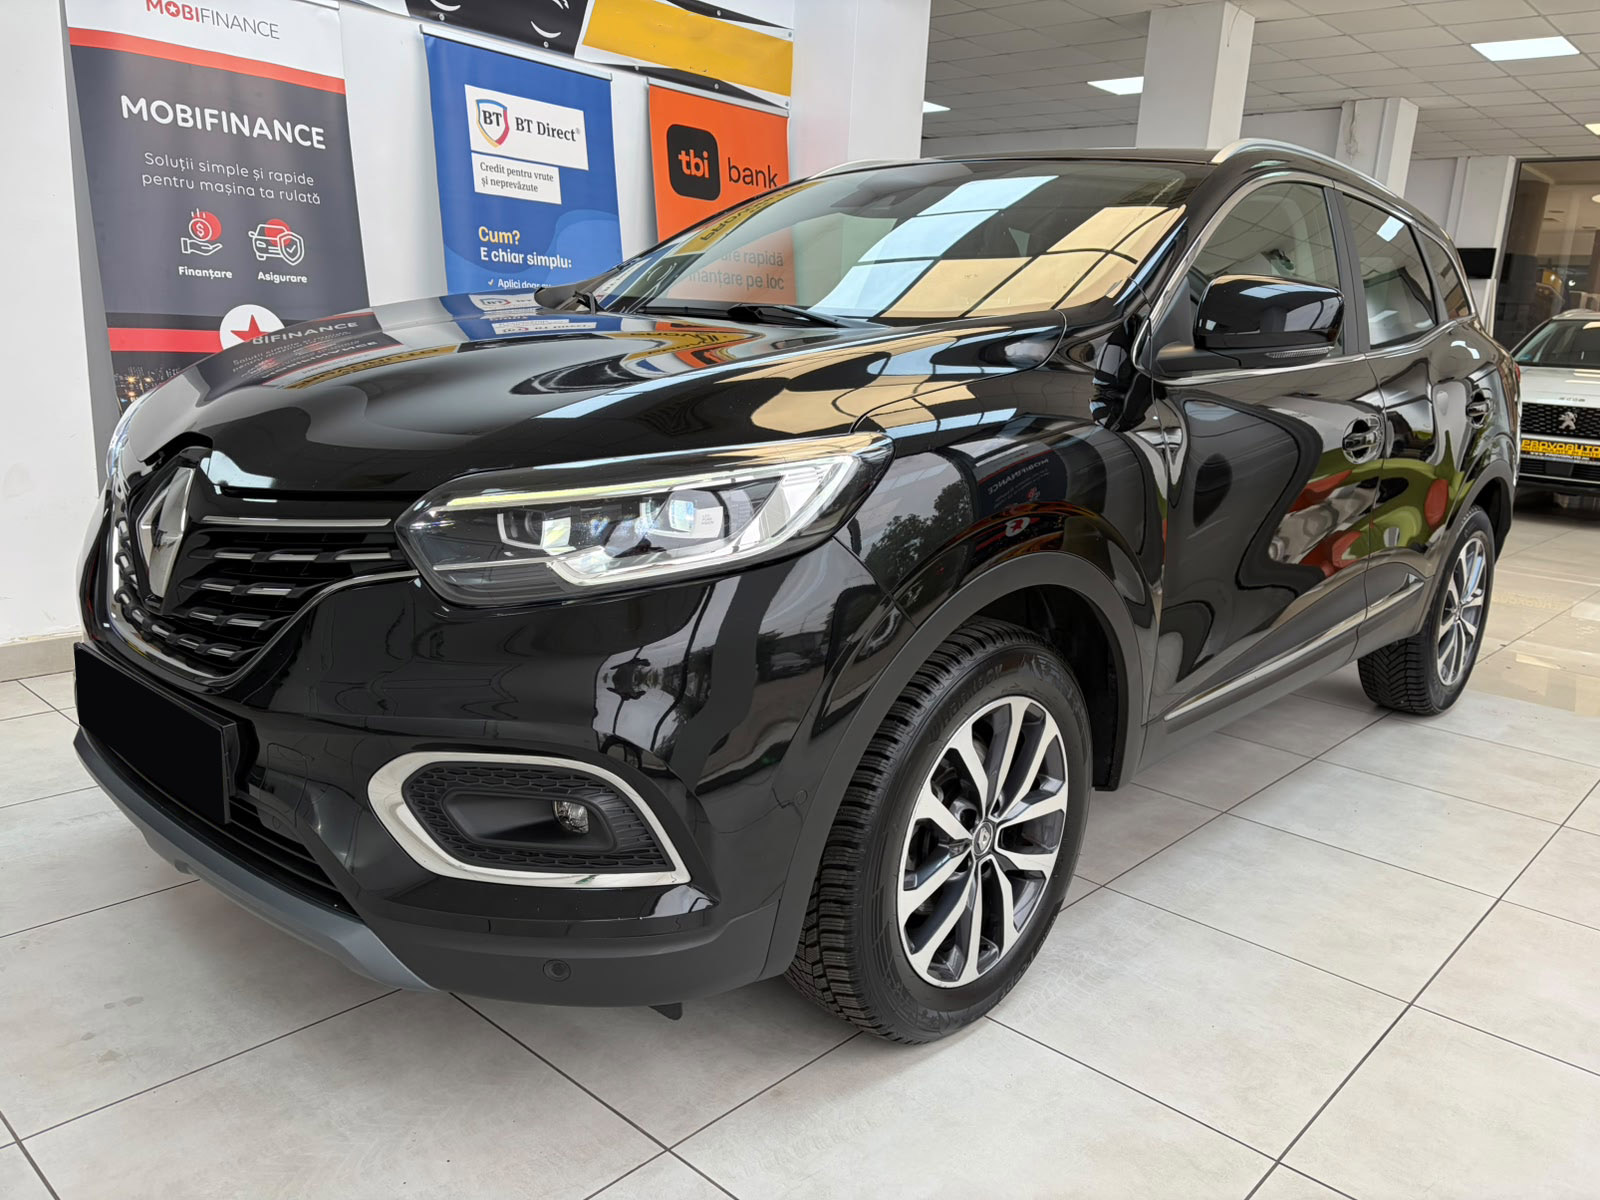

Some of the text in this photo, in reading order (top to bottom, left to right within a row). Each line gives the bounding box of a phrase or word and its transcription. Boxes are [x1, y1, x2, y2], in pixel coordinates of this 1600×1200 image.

[146, 0, 280, 40] MOBIFINANCE
[120, 95, 326, 149] MOBIFINANCE
[482, 110, 502, 127] BT
[515, 116, 533, 133] BT
[144, 152, 314, 186] Soluții simple și rapide
[480, 161, 554, 182] Credit pentru vrute
[678, 148, 778, 189] tbi bank
[142, 172, 321, 205] pentru mașina ta rulată
[481, 175, 539, 193] și neprevăzute
[478, 226, 520, 245] Cum?
[480, 246, 572, 270] E chiar simplu:
[178, 266, 233, 280] Finanțare
[257, 271, 308, 284] Asigurare
[746, 274, 763, 291] pe
[766, 273, 785, 290] loc
[497, 278, 520, 289] Aplici
